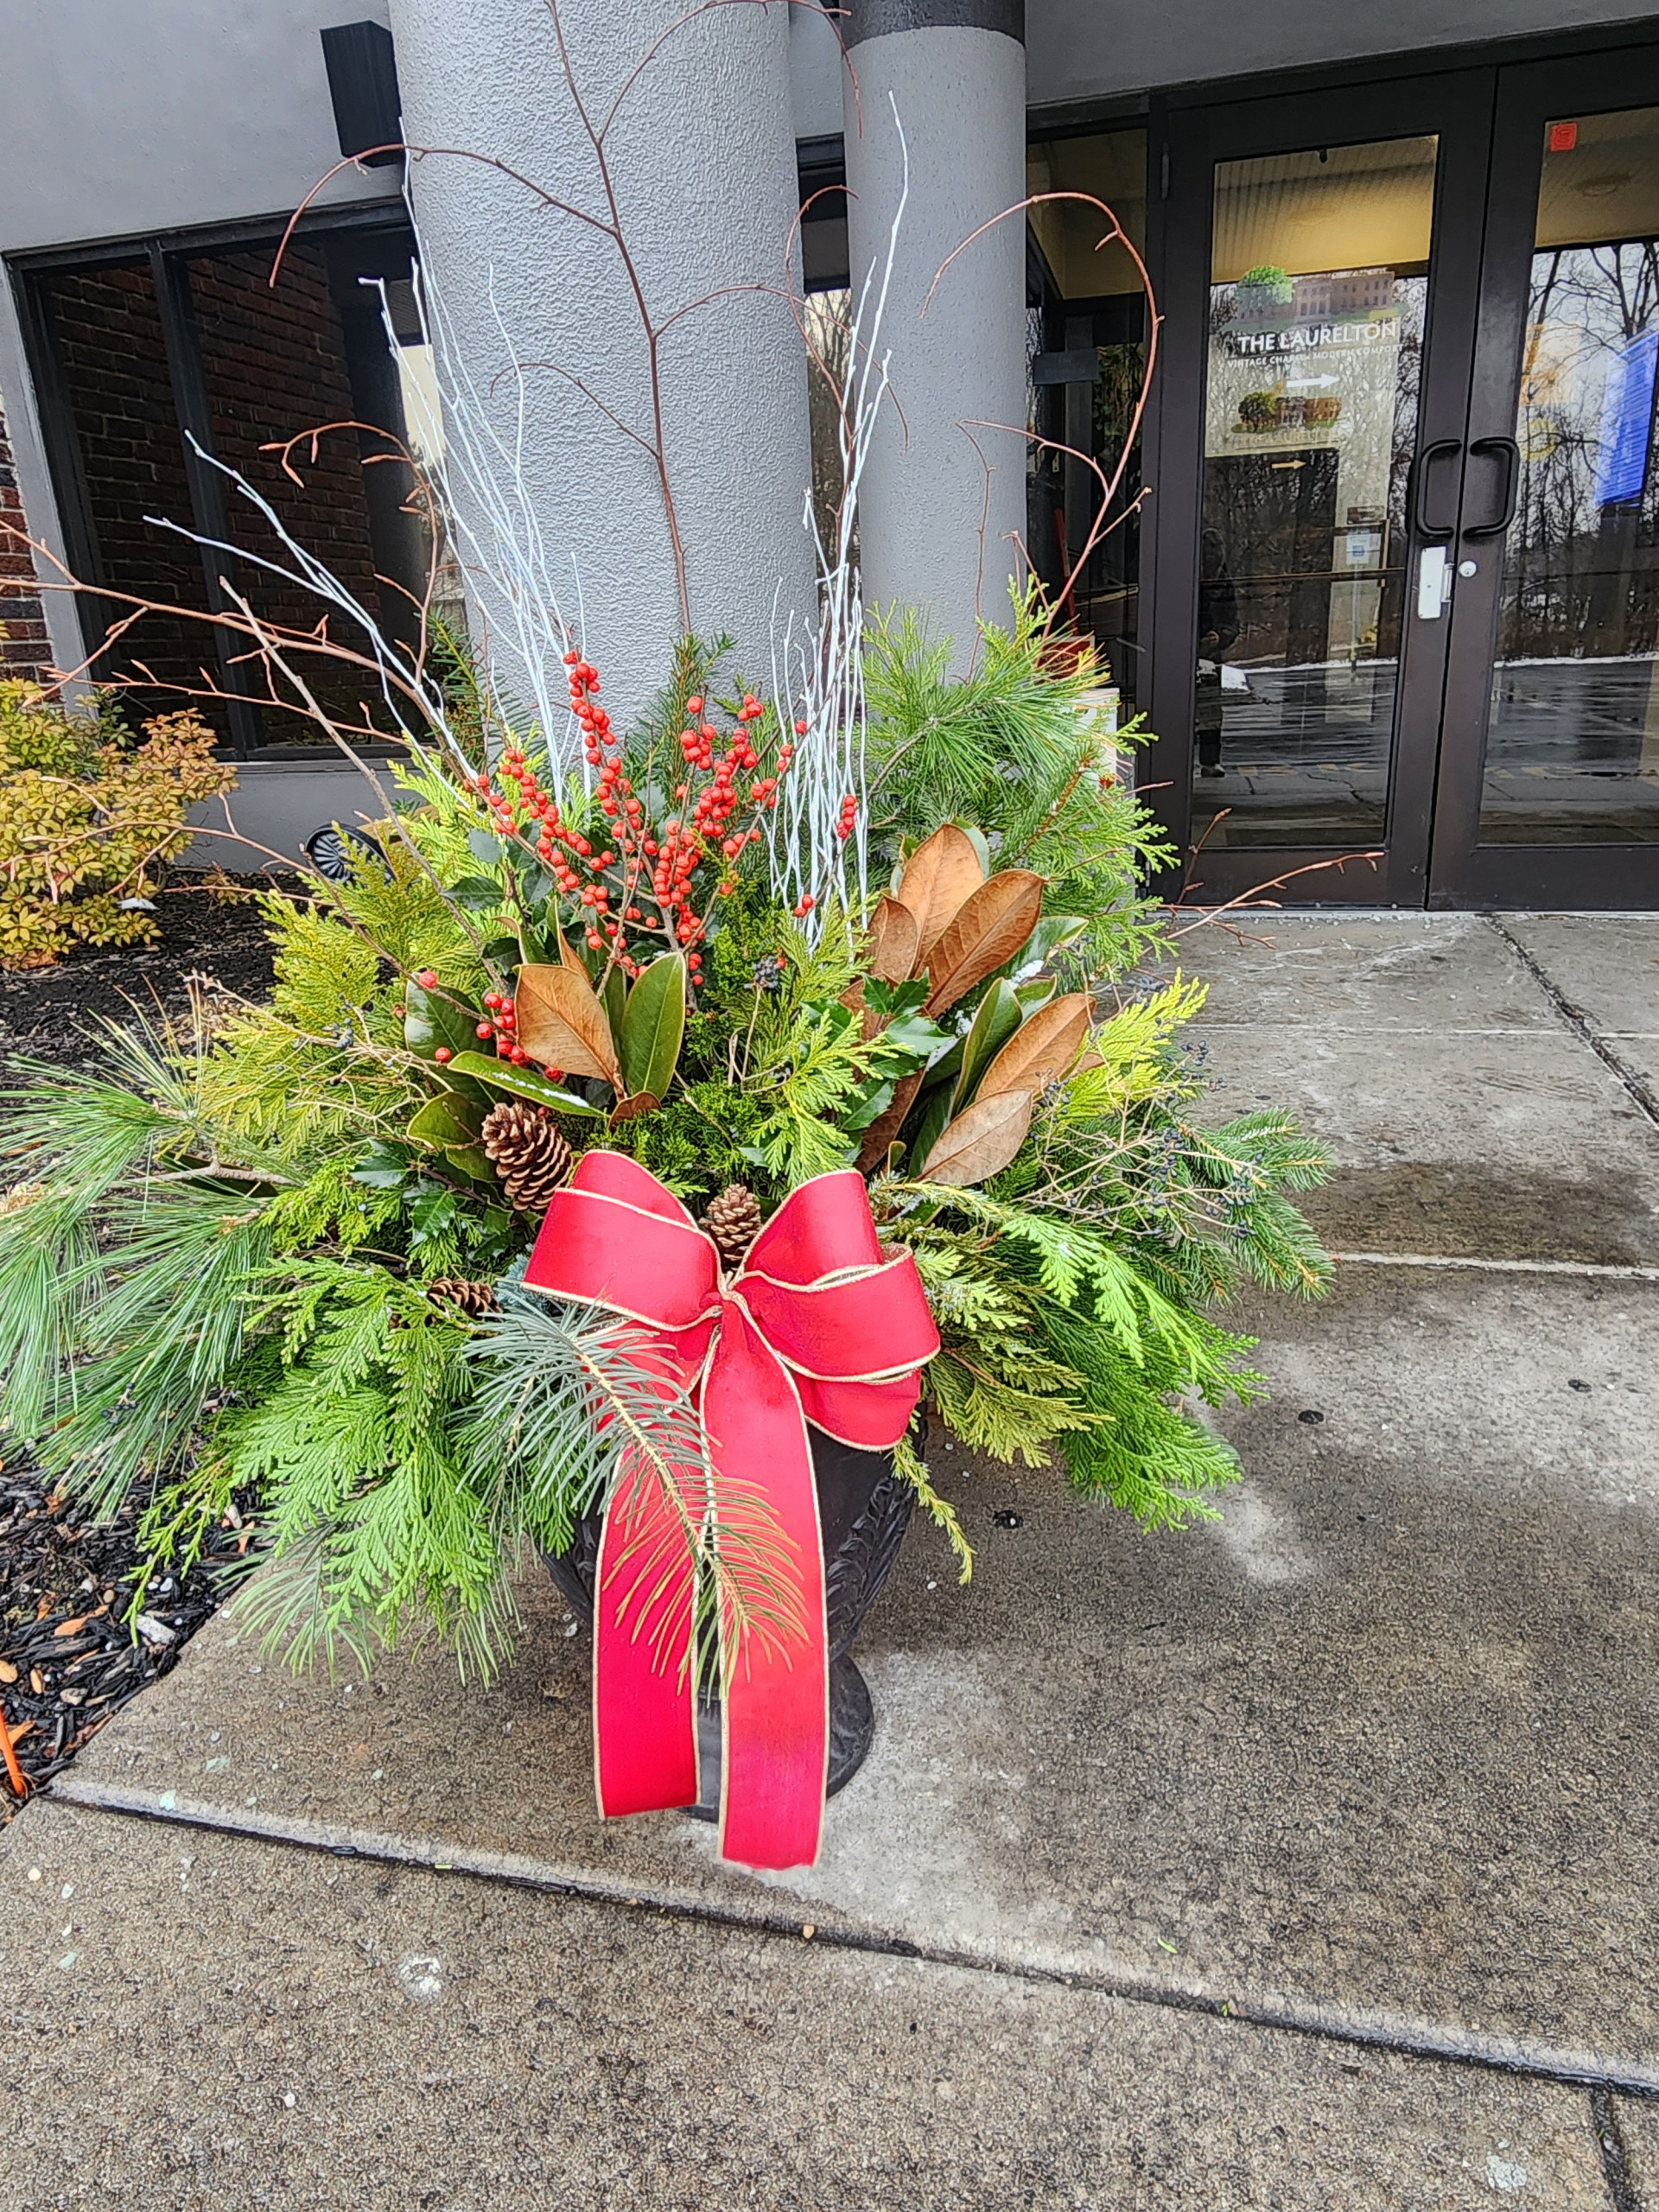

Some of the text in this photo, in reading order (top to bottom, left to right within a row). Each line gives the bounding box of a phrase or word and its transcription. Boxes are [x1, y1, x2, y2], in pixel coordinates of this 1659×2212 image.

[1237, 322, 1397, 353] THE LAURELTON
[1227, 357, 1268, 368] VINTAGE
